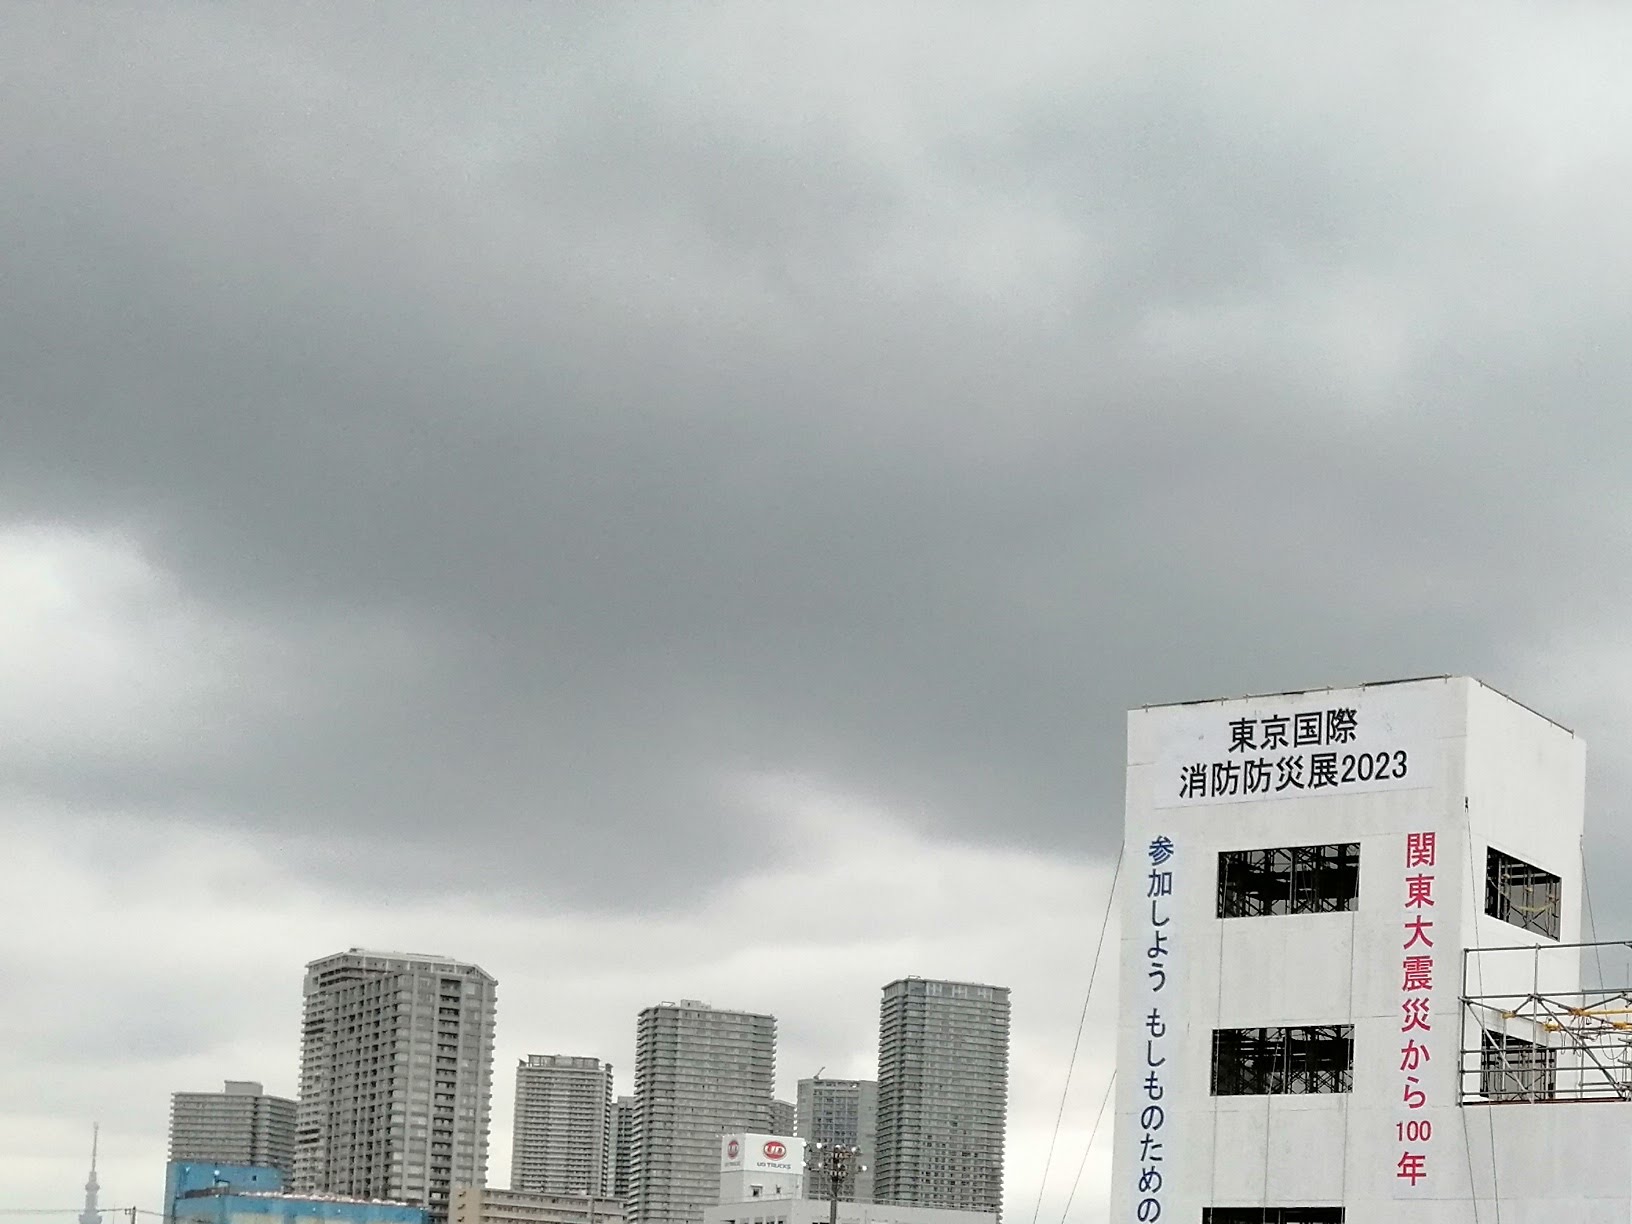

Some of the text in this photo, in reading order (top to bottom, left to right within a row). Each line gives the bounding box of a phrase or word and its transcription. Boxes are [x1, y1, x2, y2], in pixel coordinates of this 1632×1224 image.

[1179, 750, 1408, 799] 消防防災展2023
[1229, 708, 1359, 754] 東京国際
[1146, 835, 1175, 994] 参加しよう
[1396, 831, 1437, 1187] 関東大震災から100年
[767, 1162, 791, 1170] TRUCKS
[1137, 1007, 1167, 1224] もしものための
